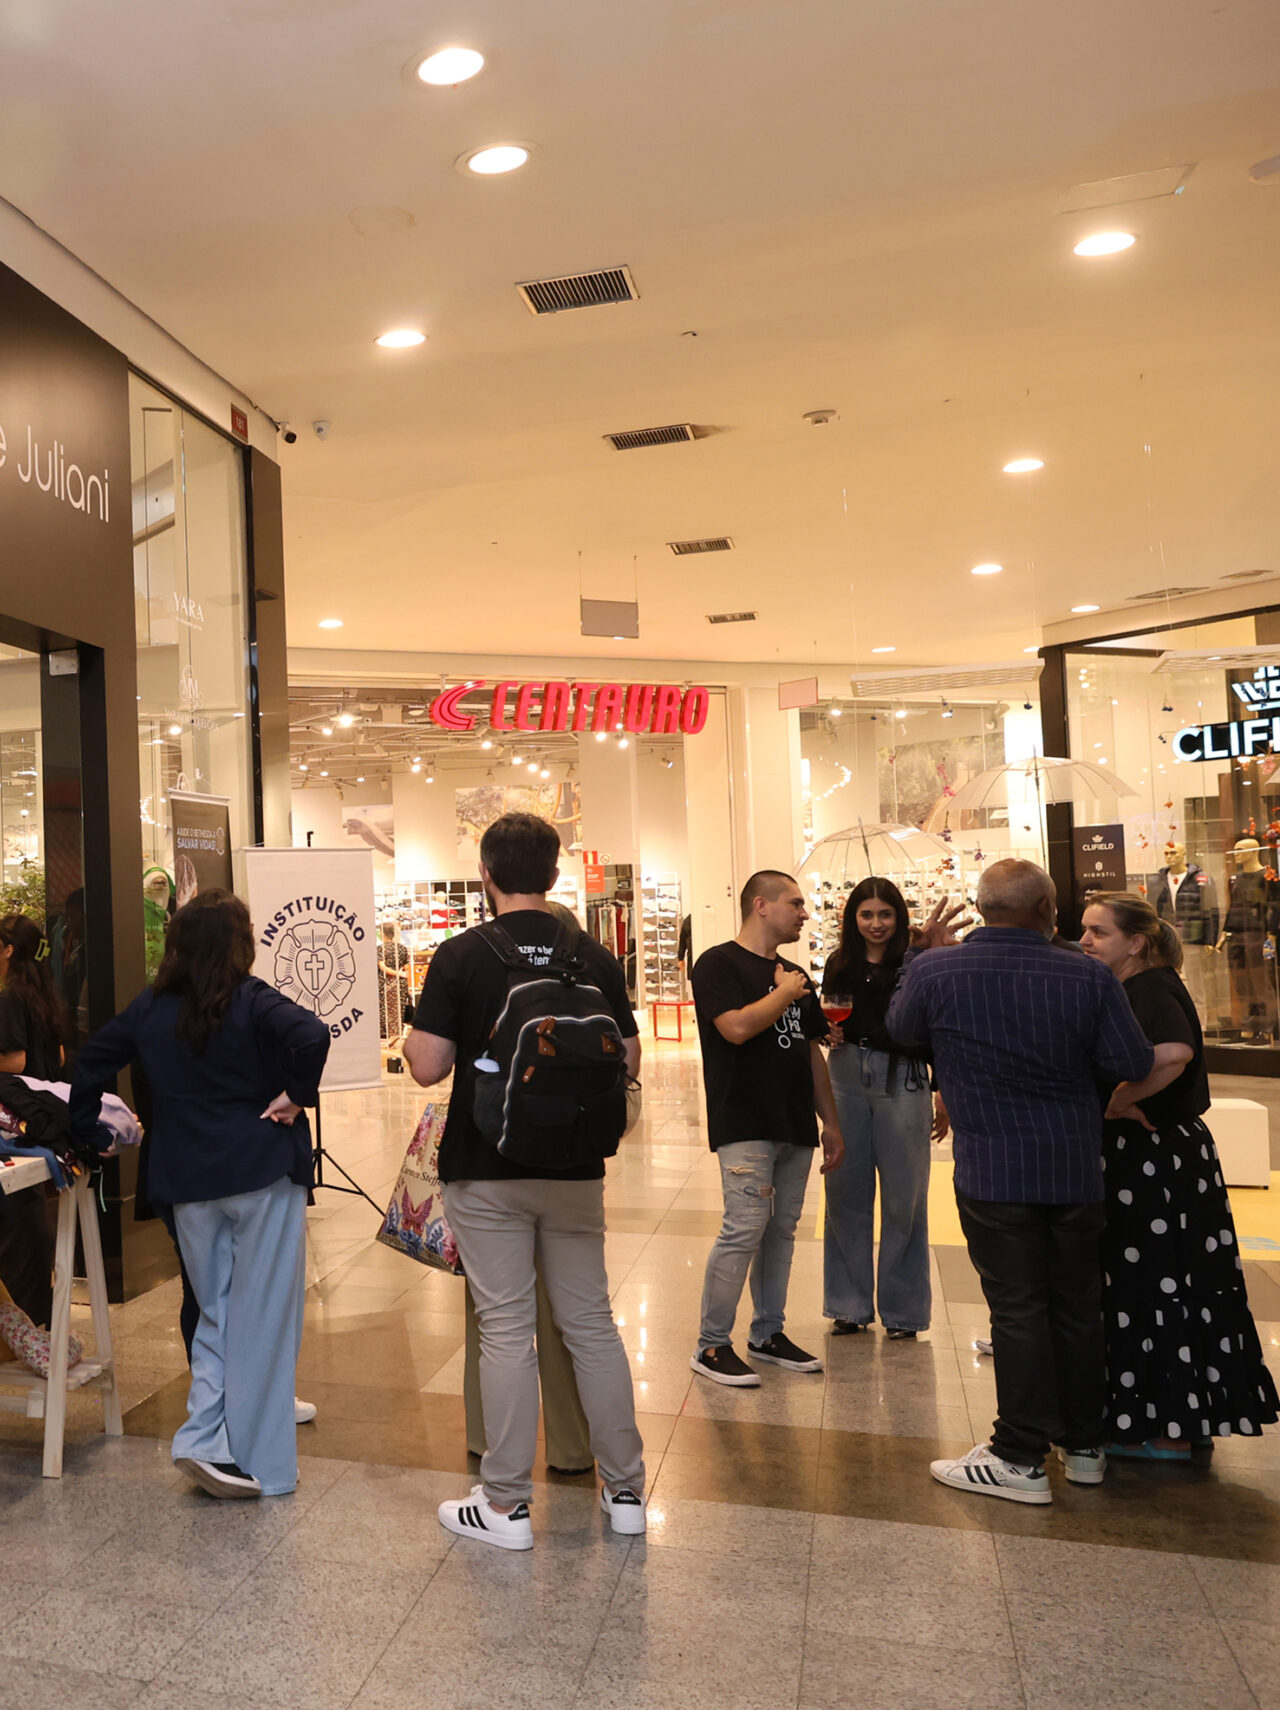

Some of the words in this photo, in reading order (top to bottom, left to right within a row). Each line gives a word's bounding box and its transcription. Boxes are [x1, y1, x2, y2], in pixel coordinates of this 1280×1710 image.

[17, 424, 110, 524] Juliani
[173, 592, 204, 623] YARA
[490, 681, 709, 734] CENTAURO
[1082, 842, 1114, 851] CLIFIELD
[260, 896, 365, 947] INSTITUIÇÃO
